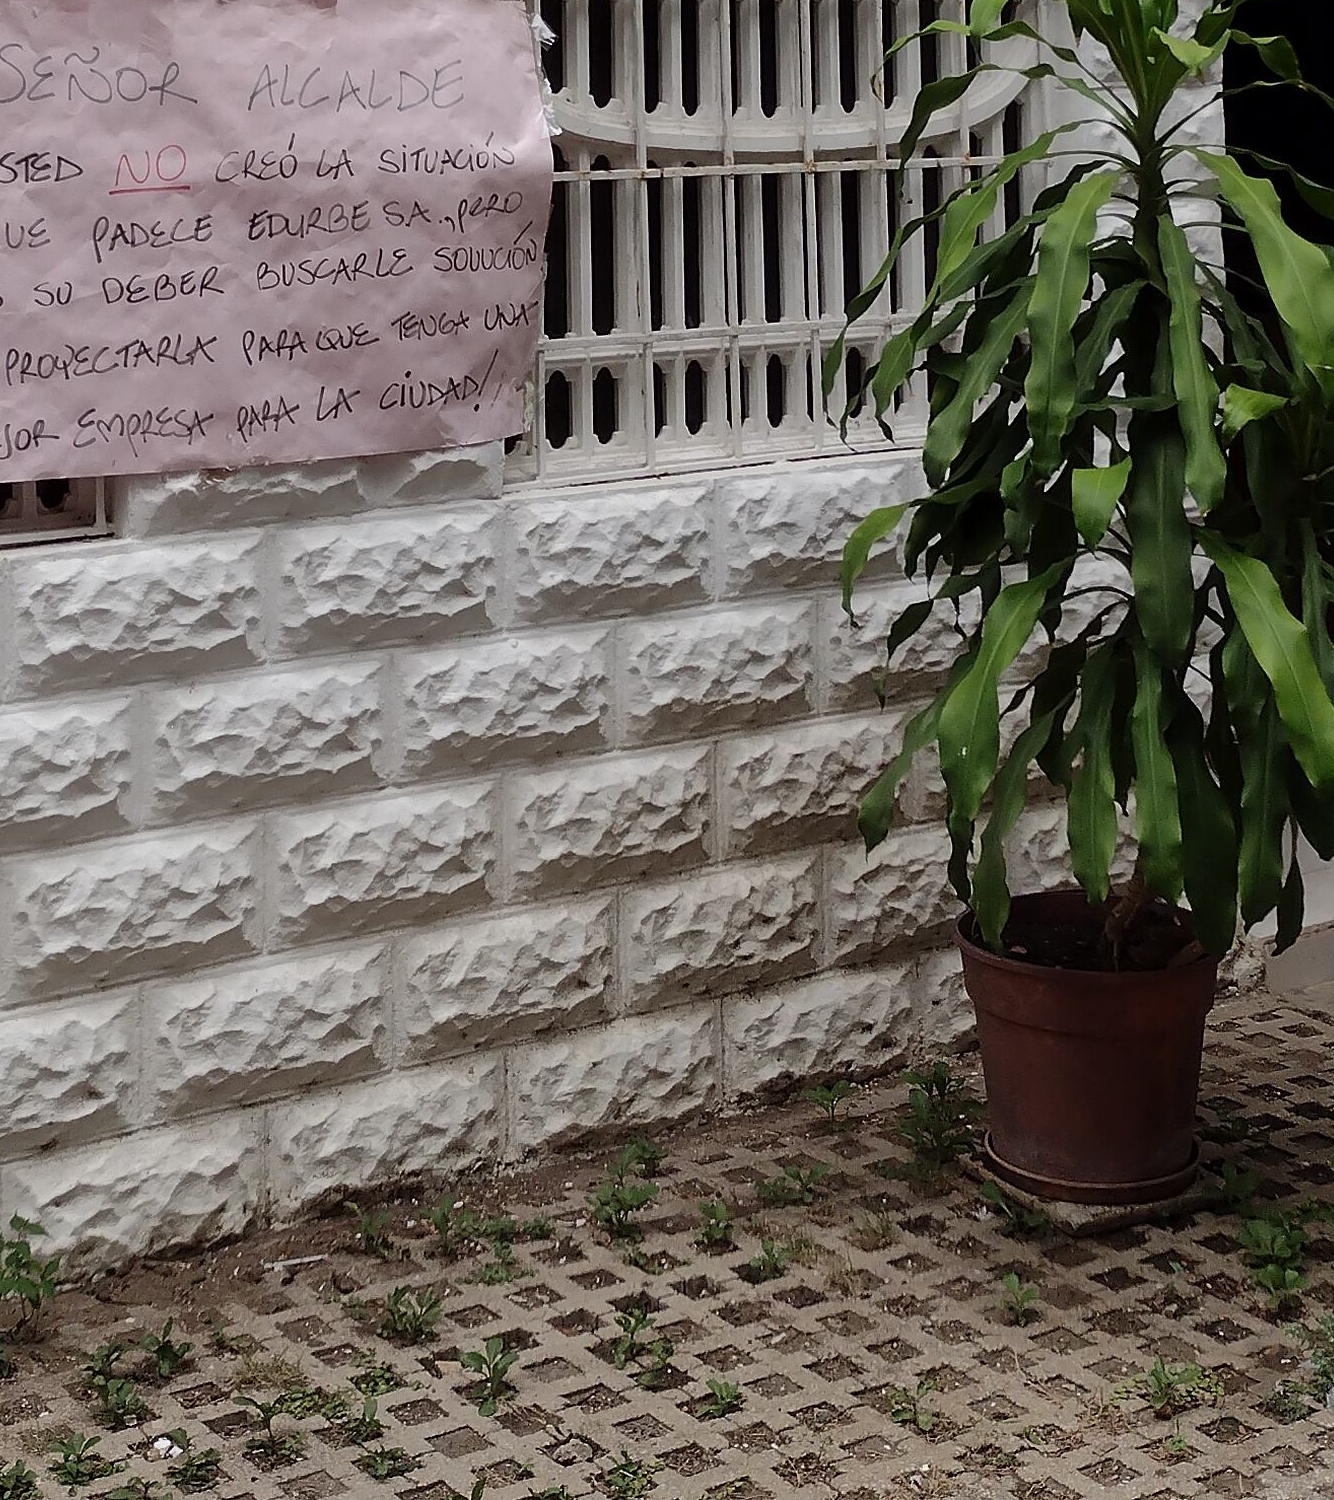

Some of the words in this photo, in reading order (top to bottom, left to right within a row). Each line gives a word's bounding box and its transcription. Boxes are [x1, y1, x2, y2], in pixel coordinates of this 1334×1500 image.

[247, 59, 464, 112] ALCALDE
[114, 144, 187, 187] NO
[216, 132, 298, 183] CREÓ
[316, 148, 355, 180] LA
[378, 131, 516, 175] SITUACIÓN
[92, 214, 214, 264] PADECE
[247, 201, 372, 241] EDURBE
[34, 281, 73, 307] SU
[101, 265, 225, 305] DEBER
[256, 247, 415, 291] BUSCARLE
[5, 333, 218, 386] PROYECTARLA
[241, 330, 308, 366] PARA
[317, 322, 380, 351] QUE
[391, 310, 470, 342] TENGA
[483, 300, 539, 331] UNA
[73, 405, 214, 458] EMPRESA
[236, 395, 300, 443] PARA
[317, 386, 361, 421] LA
